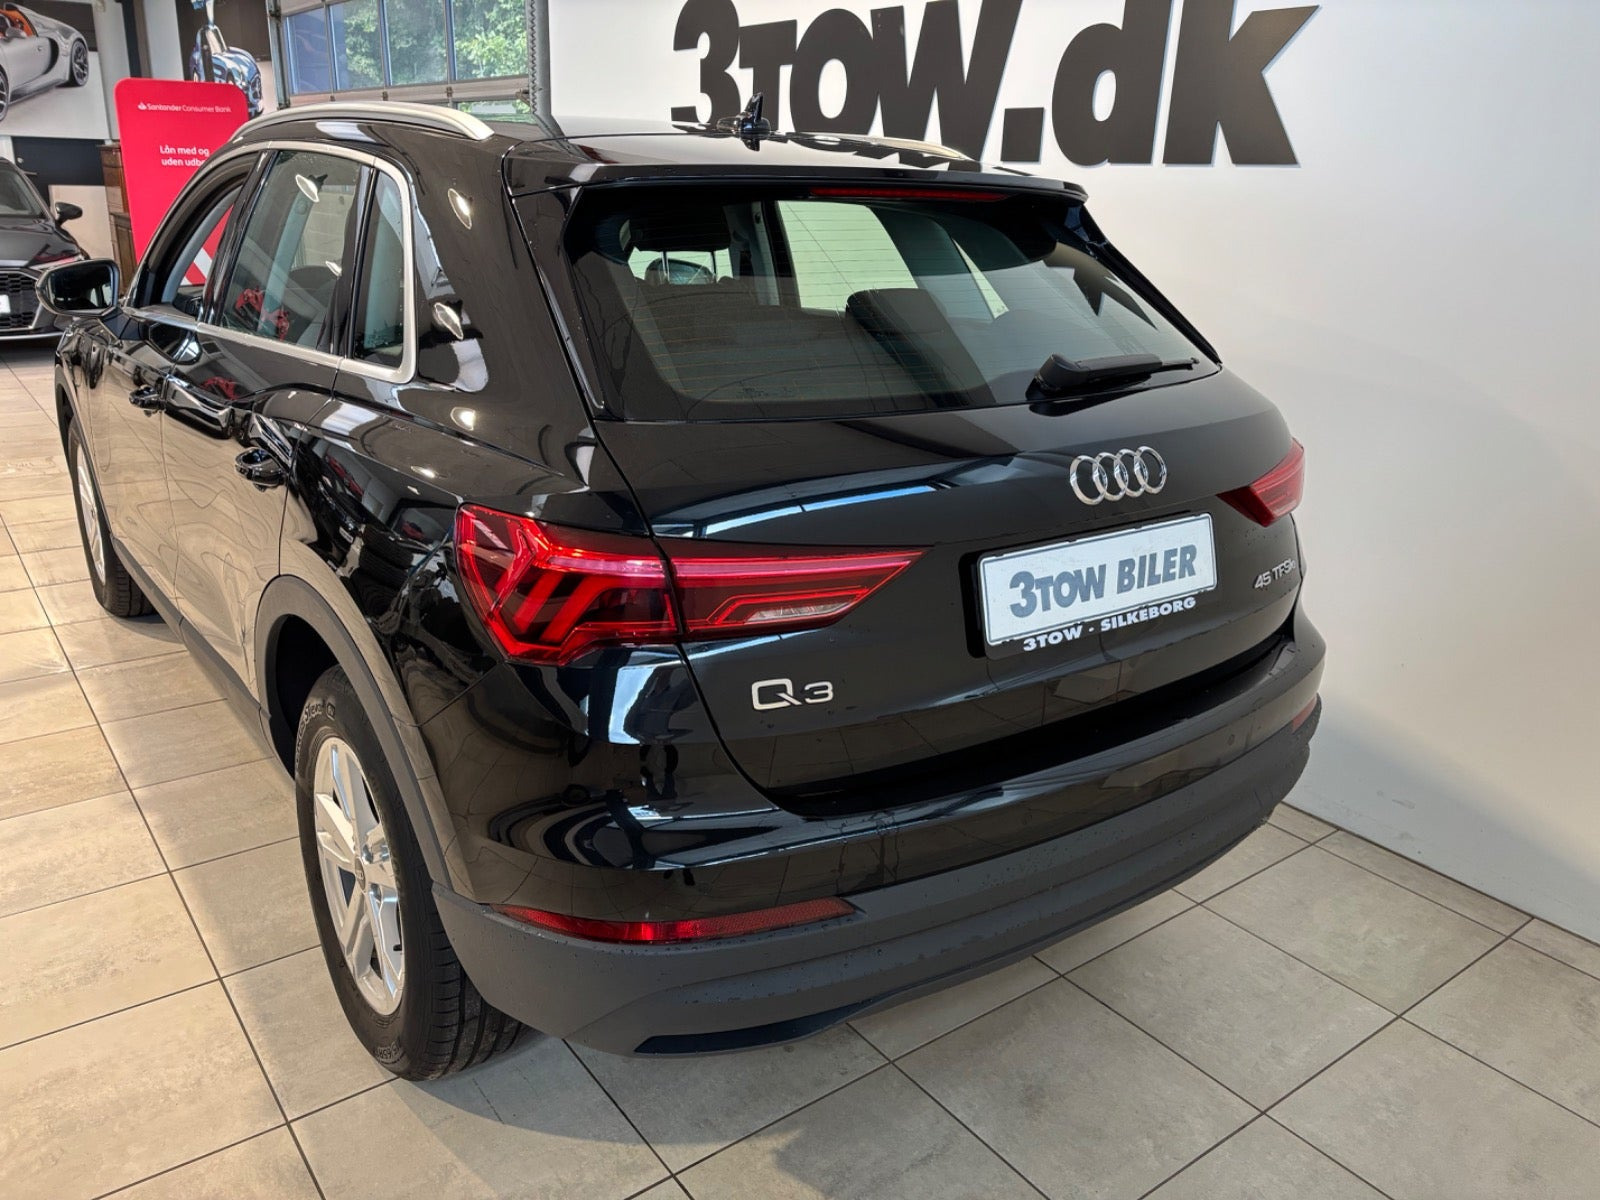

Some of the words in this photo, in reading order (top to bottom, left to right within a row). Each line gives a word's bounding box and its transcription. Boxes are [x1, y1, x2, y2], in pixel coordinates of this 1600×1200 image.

[147, 103, 181, 111] Santander
[182, 104, 215, 113] Consumer
[215, 105, 231, 113] Bank
[160, 144, 176, 154] Lån
[177, 146, 196, 155] med
[198, 148, 210, 157] og
[161, 157, 184, 166] uden
[1009, 563, 1107, 619] 3TOW
[1117, 544, 1197, 594] BILER
[1254, 570, 1272, 589] 45
[1023, 625, 1084, 652] 3TOW
[1100, 596, 1197, 632] SILKEBORG
[751, 678, 834, 711] Q3
